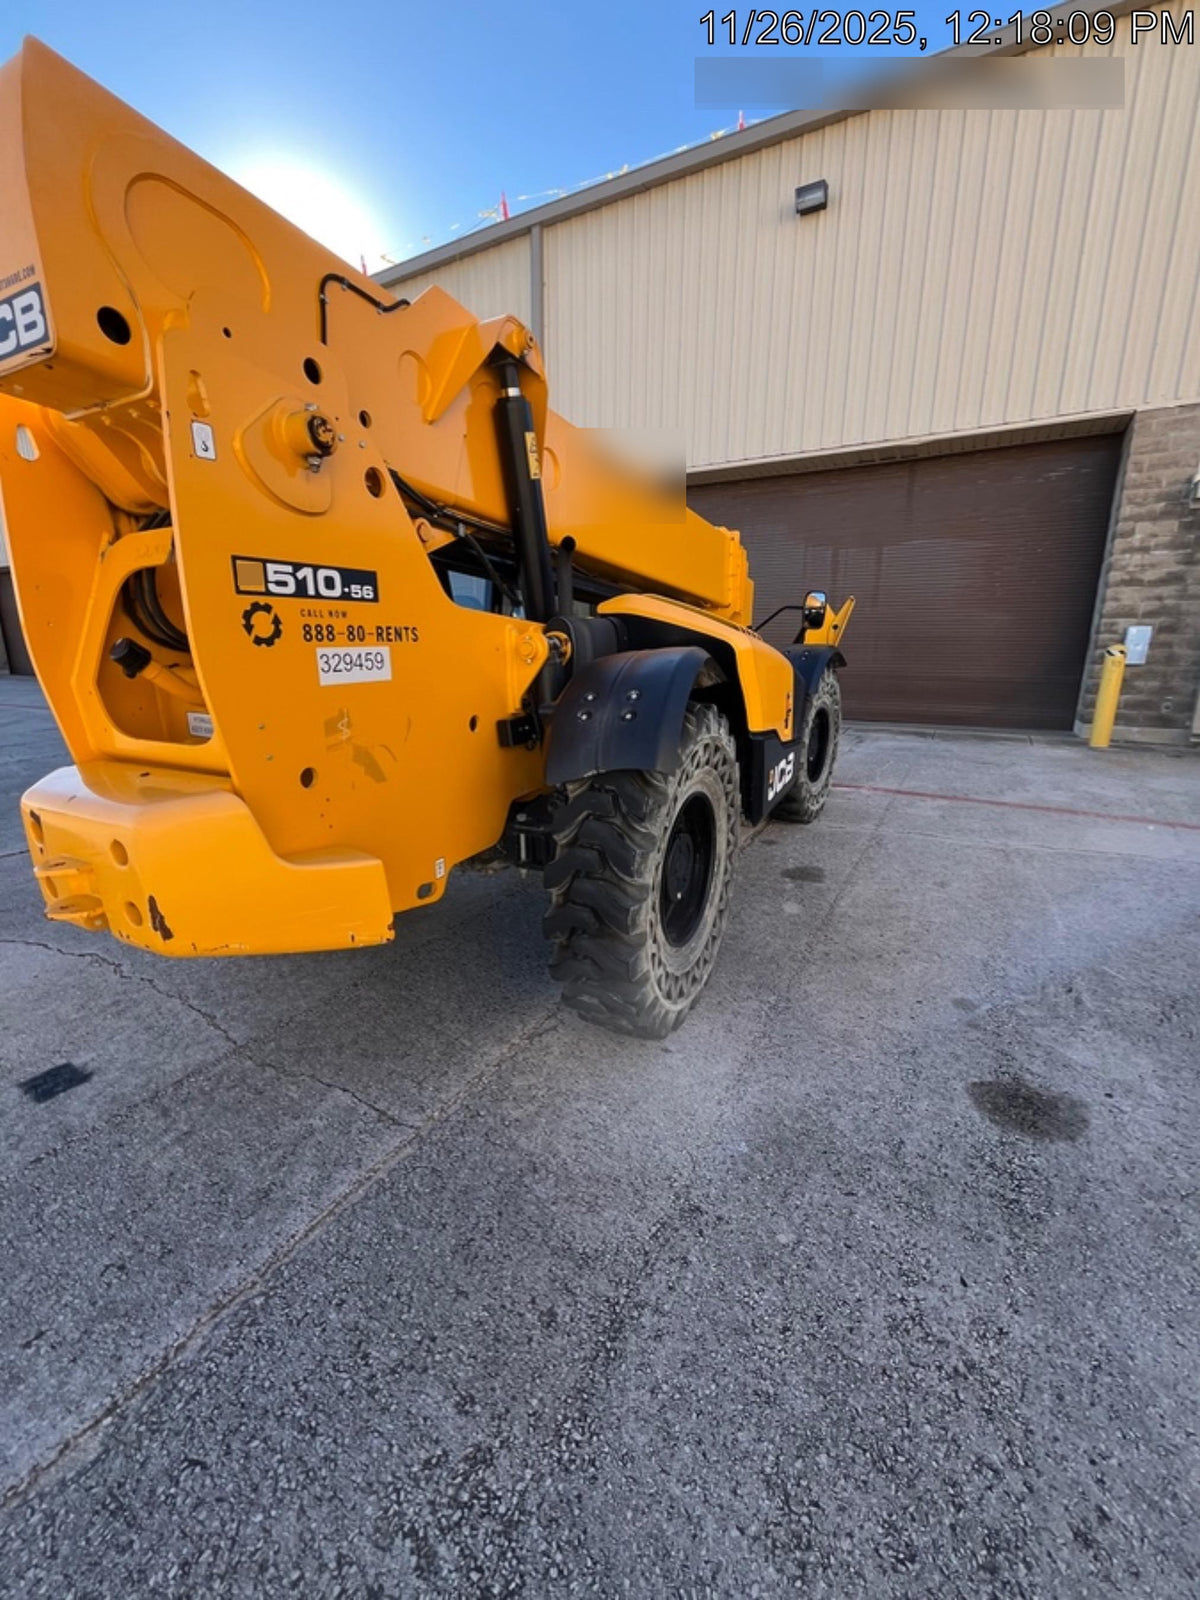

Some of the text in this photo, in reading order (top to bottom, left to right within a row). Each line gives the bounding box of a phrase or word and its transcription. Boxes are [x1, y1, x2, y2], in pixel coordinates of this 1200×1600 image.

[300, 608, 348, 619] CALL NOW
[303, 624, 419, 643] 888-80-RENTS
[319, 652, 385, 674] 329459
[767, 751, 795, 801] JCB
